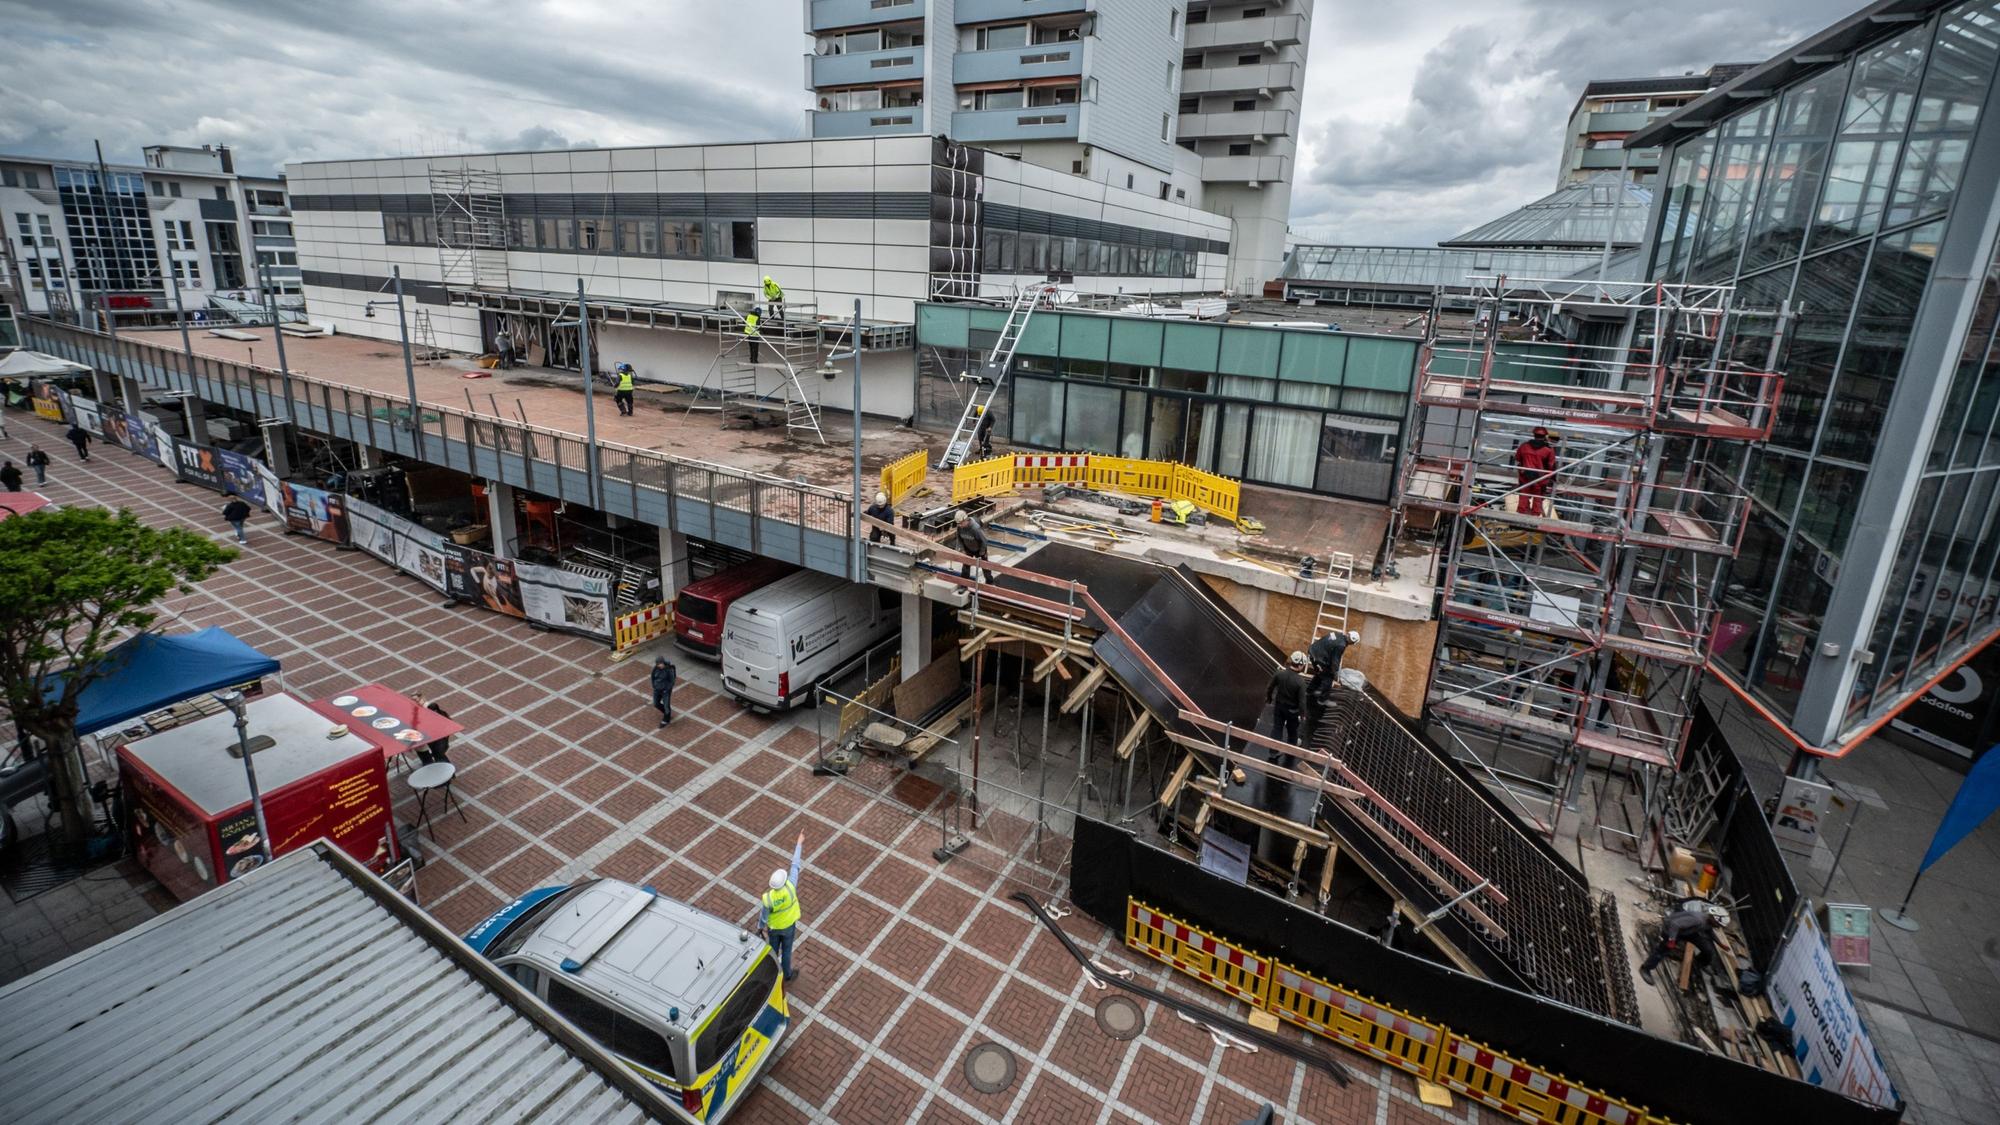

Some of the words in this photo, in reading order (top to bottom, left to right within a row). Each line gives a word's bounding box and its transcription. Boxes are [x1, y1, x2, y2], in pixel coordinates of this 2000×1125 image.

[1919, 695, 1974, 721] odafone
[470, 900, 523, 939] POLIZEI
[702, 1051, 738, 1097] POLIZEI
